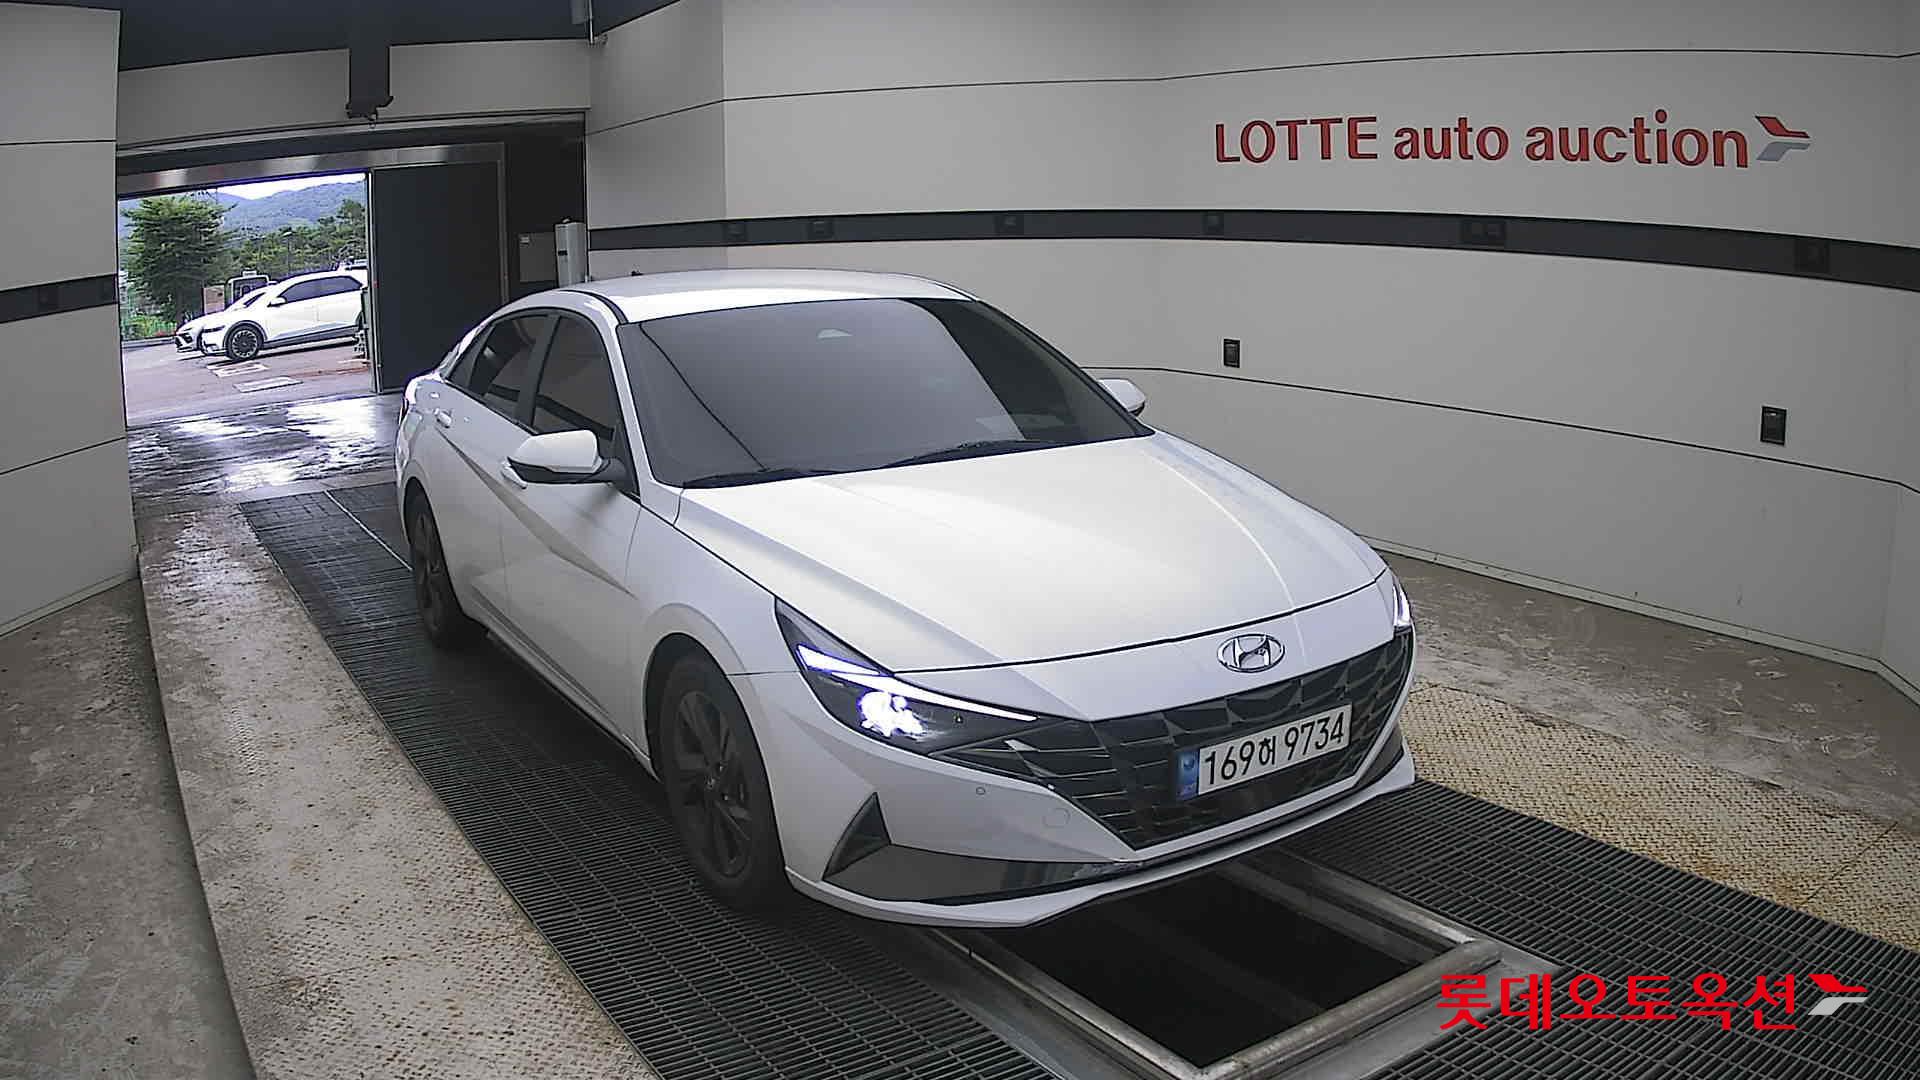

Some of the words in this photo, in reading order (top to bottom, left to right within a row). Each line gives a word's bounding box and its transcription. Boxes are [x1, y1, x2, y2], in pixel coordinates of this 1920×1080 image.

[1215, 116, 1378, 163] LOTTE
[1394, 117, 1509, 161] auto
[1525, 109, 1749, 168] auction
[1204, 735, 1276, 785] 169허
[1284, 712, 1344, 761] 9734
